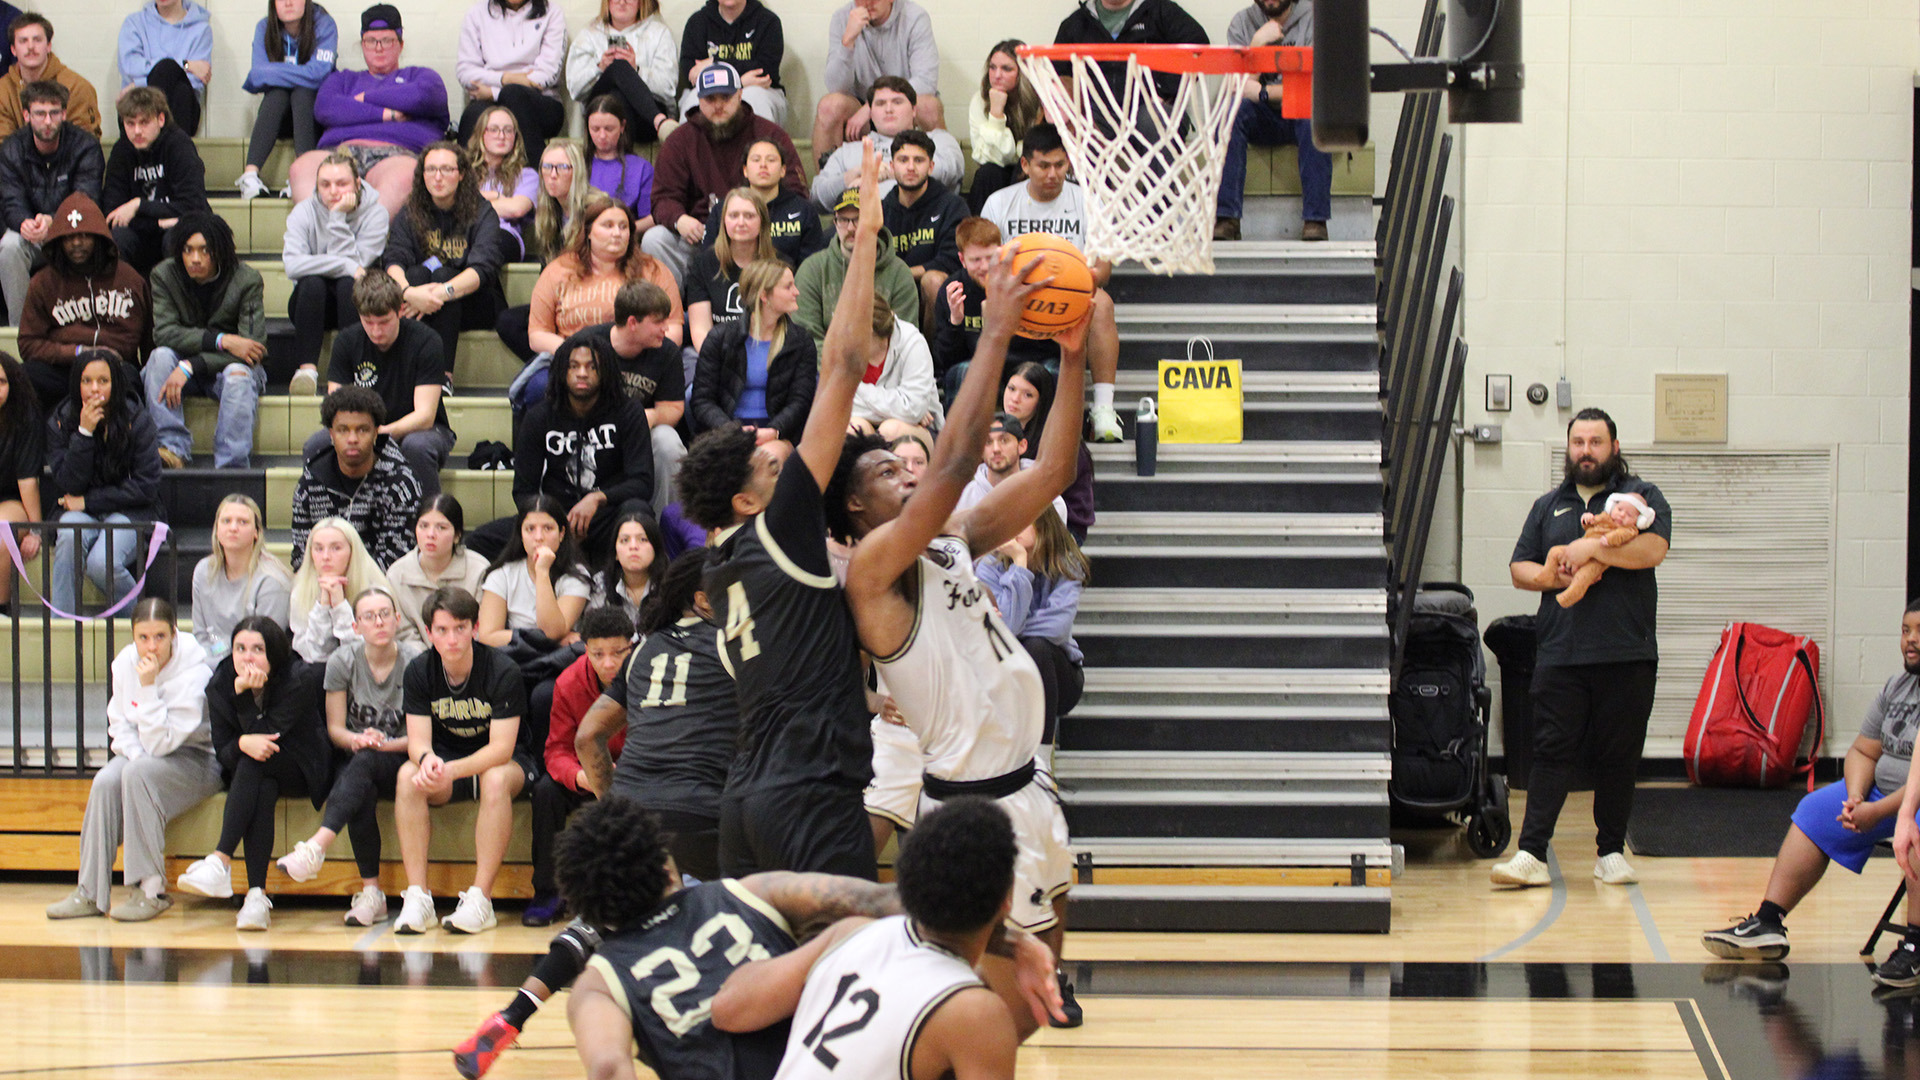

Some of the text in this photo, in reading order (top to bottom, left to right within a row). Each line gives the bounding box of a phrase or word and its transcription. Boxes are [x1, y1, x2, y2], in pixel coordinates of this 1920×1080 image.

[1007, 218, 1080, 235] FERRUM
[1163, 365, 1233, 389] CAVA
[545, 423, 617, 456] GOAT
[725, 580, 761, 662] 4
[640, 652, 692, 708] 11
[630, 911, 772, 1040] 23
[802, 972, 880, 1071] 12
